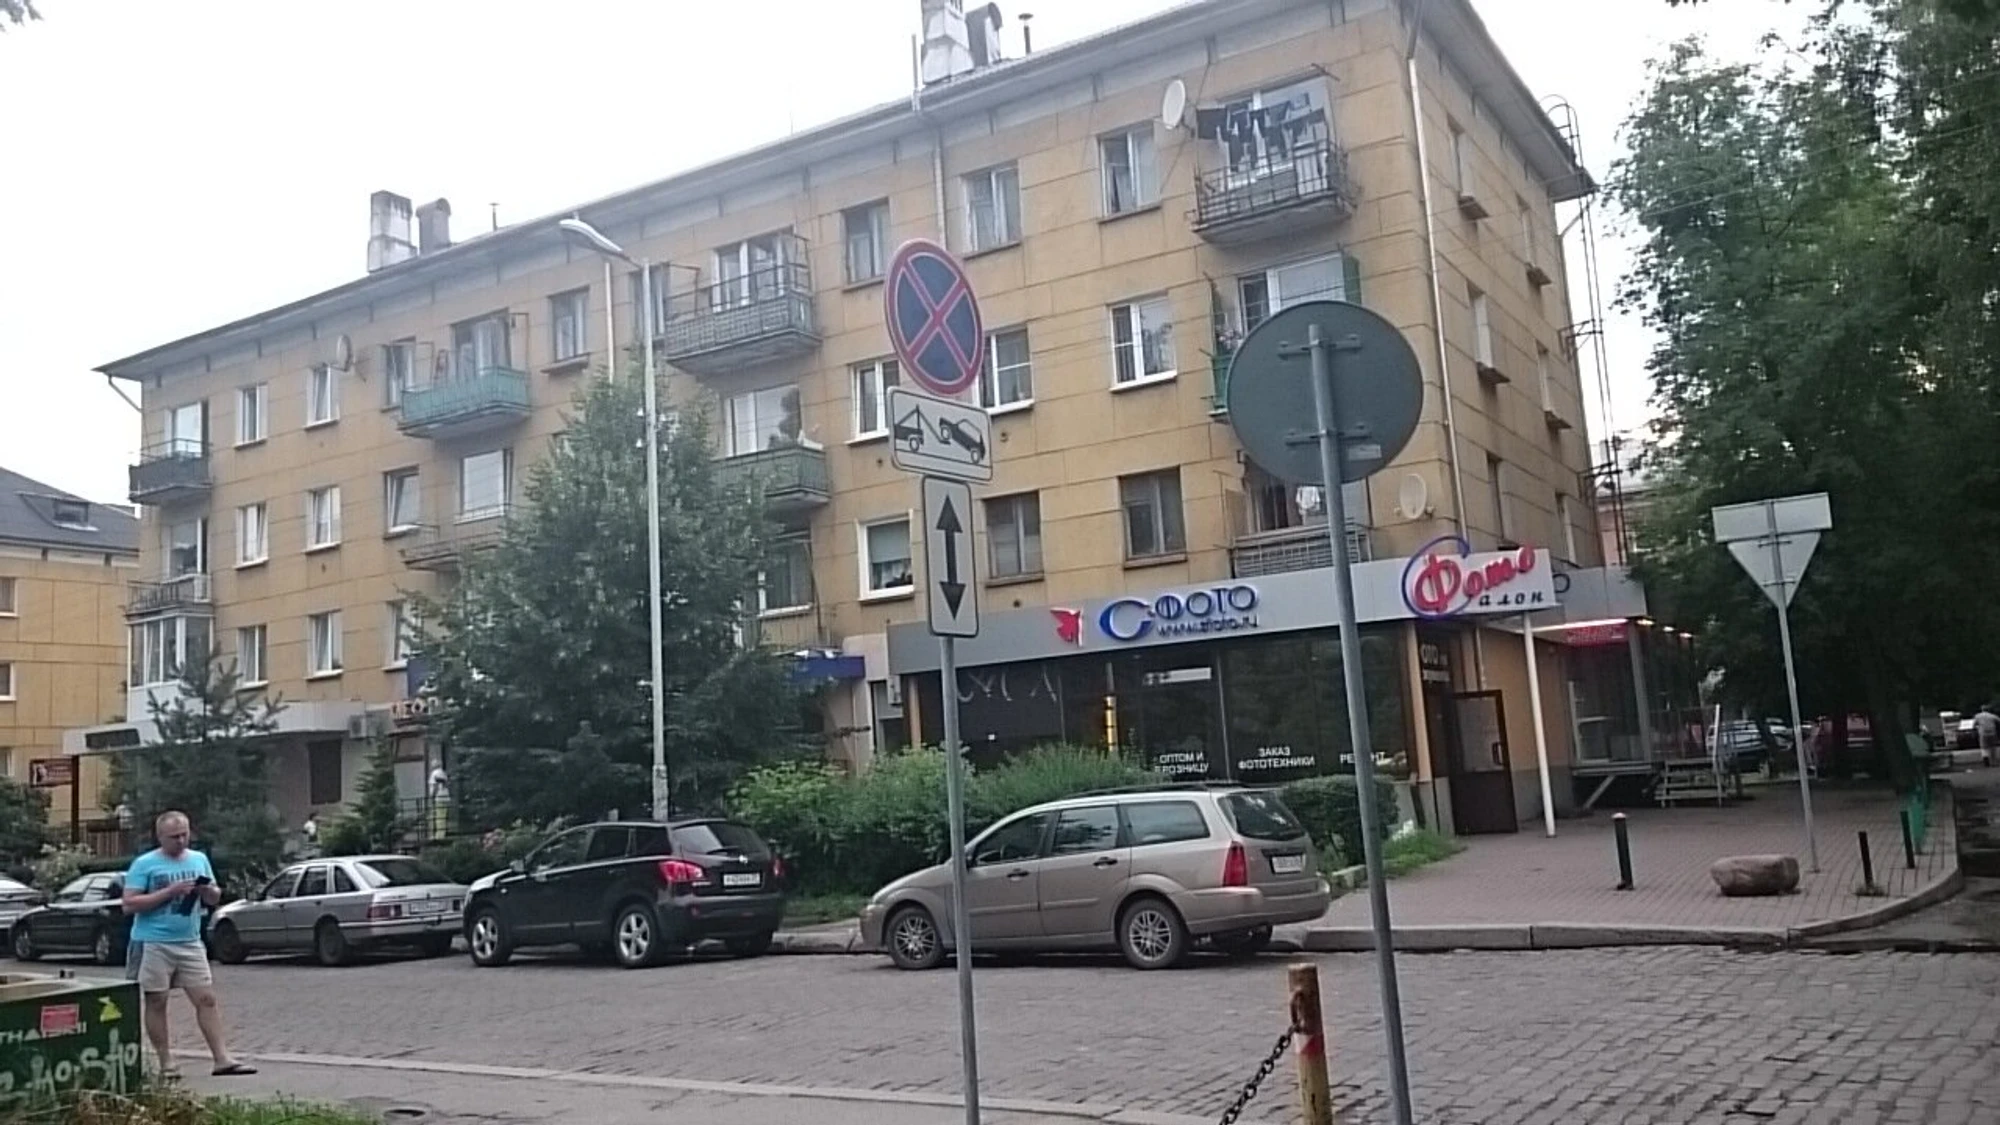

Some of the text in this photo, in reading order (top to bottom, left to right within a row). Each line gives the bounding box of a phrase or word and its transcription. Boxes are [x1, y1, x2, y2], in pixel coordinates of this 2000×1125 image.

[1413, 542, 1537, 613] Фото
[1159, 751, 1205, 764] ОПТОМ И
[1258, 746, 1291, 757] ЗАКАЗ
[1162, 762, 1209, 774] РОЗНИЦУ
[1238, 755, 1316, 770] ФОТОТЕХНИКИ
